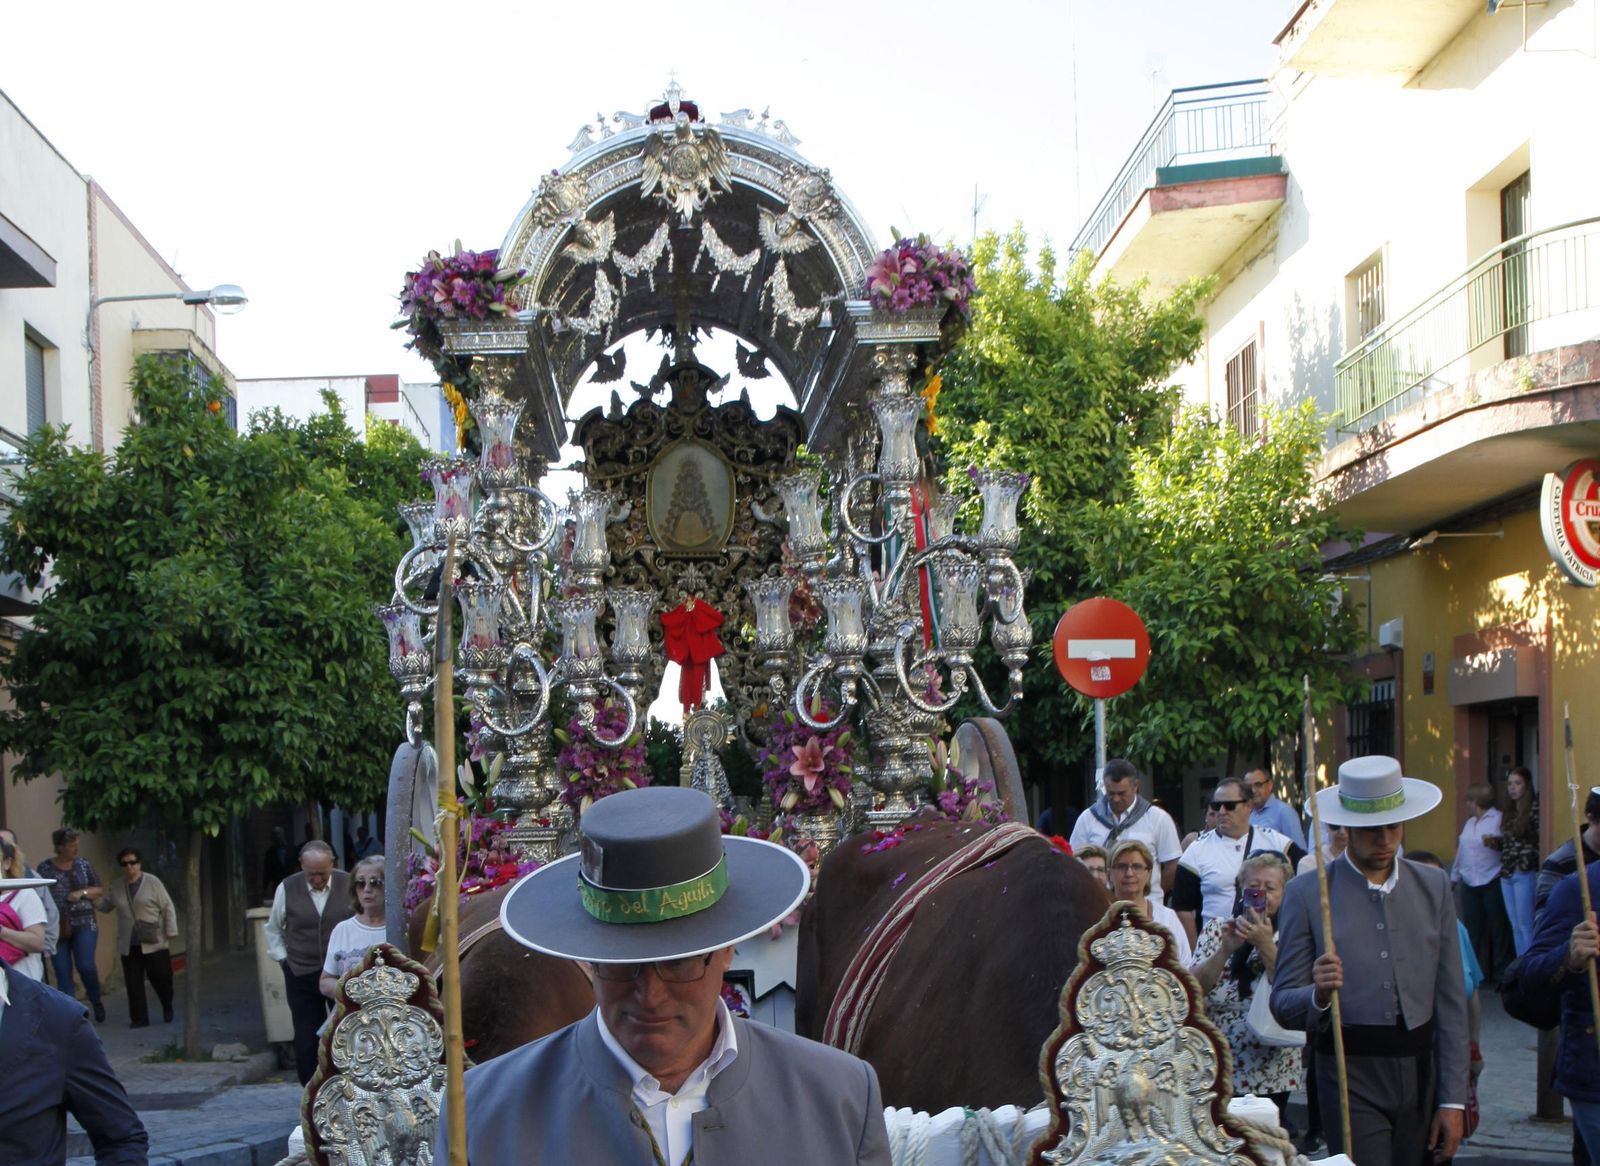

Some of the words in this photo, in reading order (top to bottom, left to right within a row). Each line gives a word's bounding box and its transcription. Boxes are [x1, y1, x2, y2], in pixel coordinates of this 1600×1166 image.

[1575, 501, 1600, 516] Cru
[1564, 550, 1594, 582] PATRICIA
[617, 893, 650, 914] del
